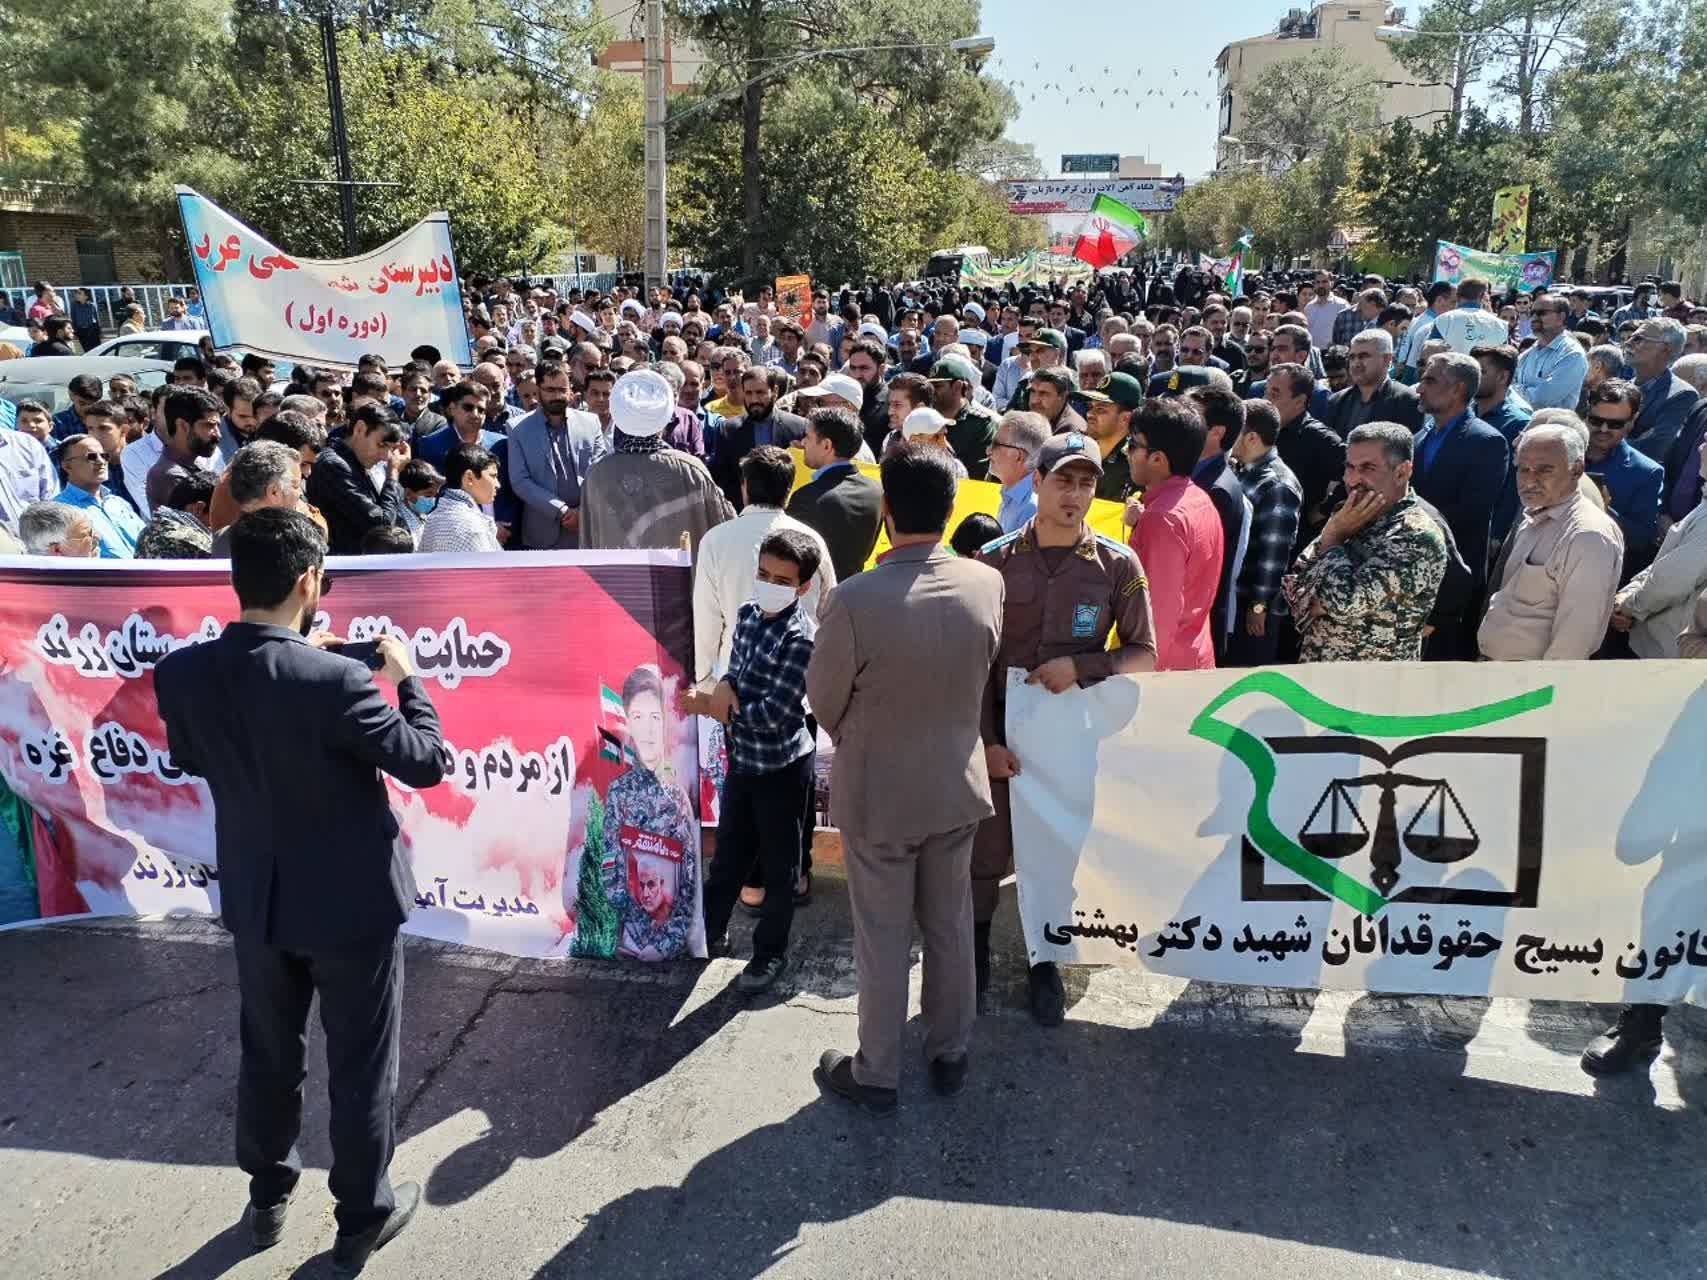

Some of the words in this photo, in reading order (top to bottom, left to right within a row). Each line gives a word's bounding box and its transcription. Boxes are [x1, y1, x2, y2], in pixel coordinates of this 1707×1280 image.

[368, 253, 453, 297] دبیرستن
[41, 620, 108, 672] زرند
[415, 625, 504, 681] حمایت
[26, 730, 73, 778] غزه
[89, 726, 148, 779] دفاع
[464, 756, 477, 790] و
[483, 746, 542, 794] مردم
[550, 743, 570, 796] از
[133, 854, 186, 888] زرند
[452, 889, 540, 917] مدیریت
[1043, 908, 1139, 952] بهشتی
[1147, 915, 1223, 958] دکتر
[1233, 914, 1312, 963] شهید
[1322, 912, 1503, 971] حقوقدانان
[1513, 933, 1604, 976] بسیج
